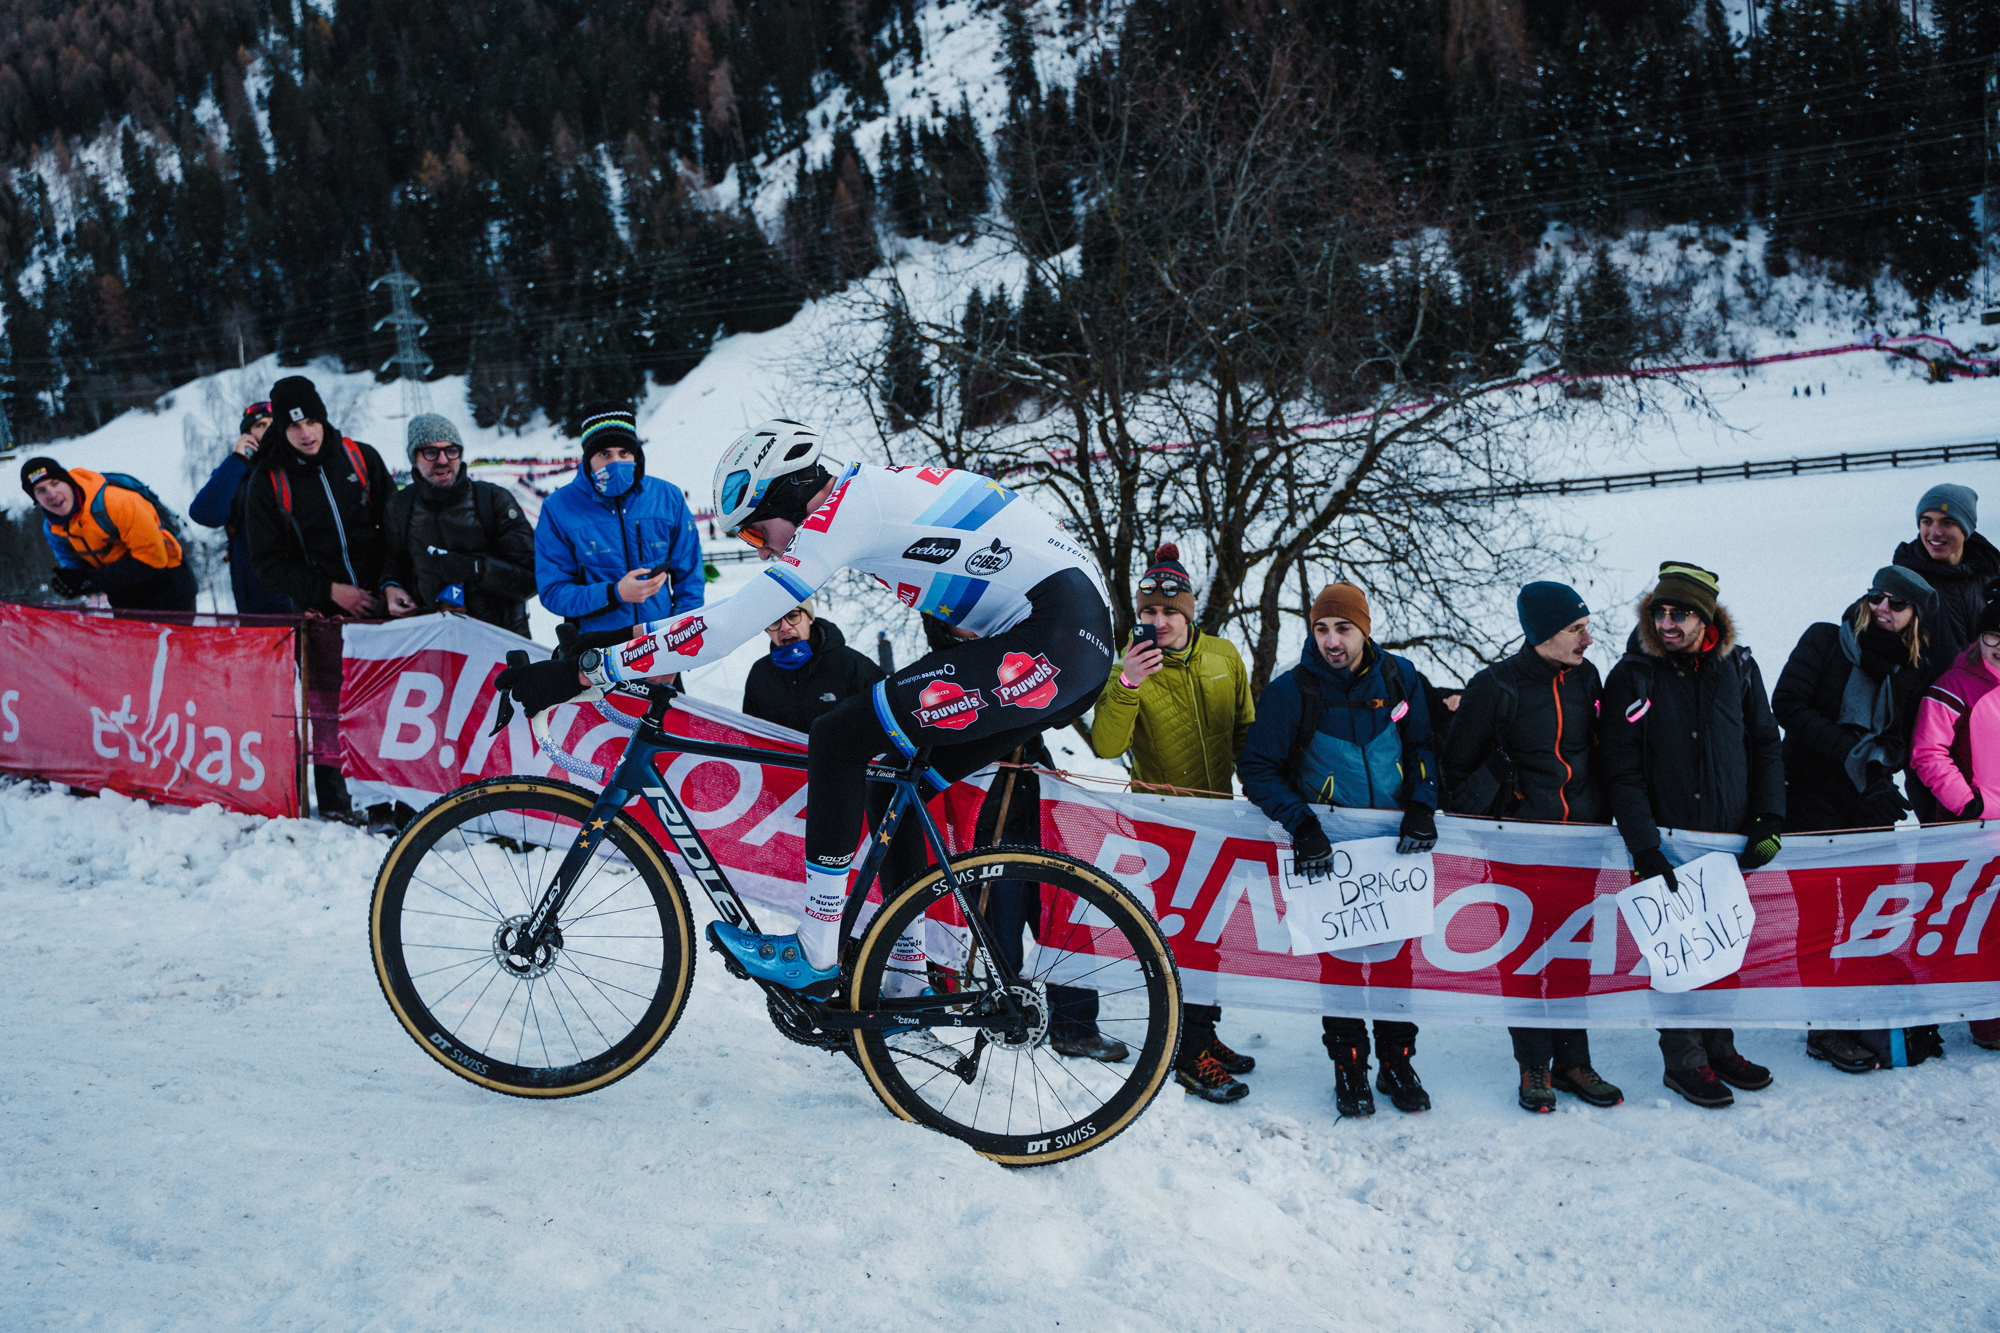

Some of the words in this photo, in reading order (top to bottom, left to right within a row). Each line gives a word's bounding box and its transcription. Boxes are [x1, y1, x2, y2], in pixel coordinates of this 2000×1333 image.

[753, 436, 777, 469] LAZER
[908, 542, 955, 559] cebon
[971, 553, 1003, 570] CIBEL
[1047, 537, 1090, 563] DOLTCINI
[667, 619, 704, 647] Pauwels
[1078, 628, 1110, 658] DOLTCINI
[623, 638, 656, 663] Pauwels
[1000, 663, 1053, 701] Pauwels
[90, 627, 266, 795] ethias
[920, 695, 980, 723] Pauwels
[876, 769, 896, 778] finish
[642, 787, 750, 931] RIDLE
[978, 864, 1005, 879] DT
[932, 869, 975, 896] SWSS
[1339, 867, 1428, 906] DRAGO
[527, 876, 564, 938] RIDLEY
[1321, 901, 1390, 941] STATT
[1653, 904, 1750, 977] BASILE
[979, 946, 1008, 996] RIDLEY
[898, 1017, 920, 1025] CEMA
[428, 1032, 452, 1049] DT
[450, 1048, 490, 1075] SWISS
[1026, 1139, 1051, 1154] DT
[1055, 1122, 1097, 1149] SWISS
